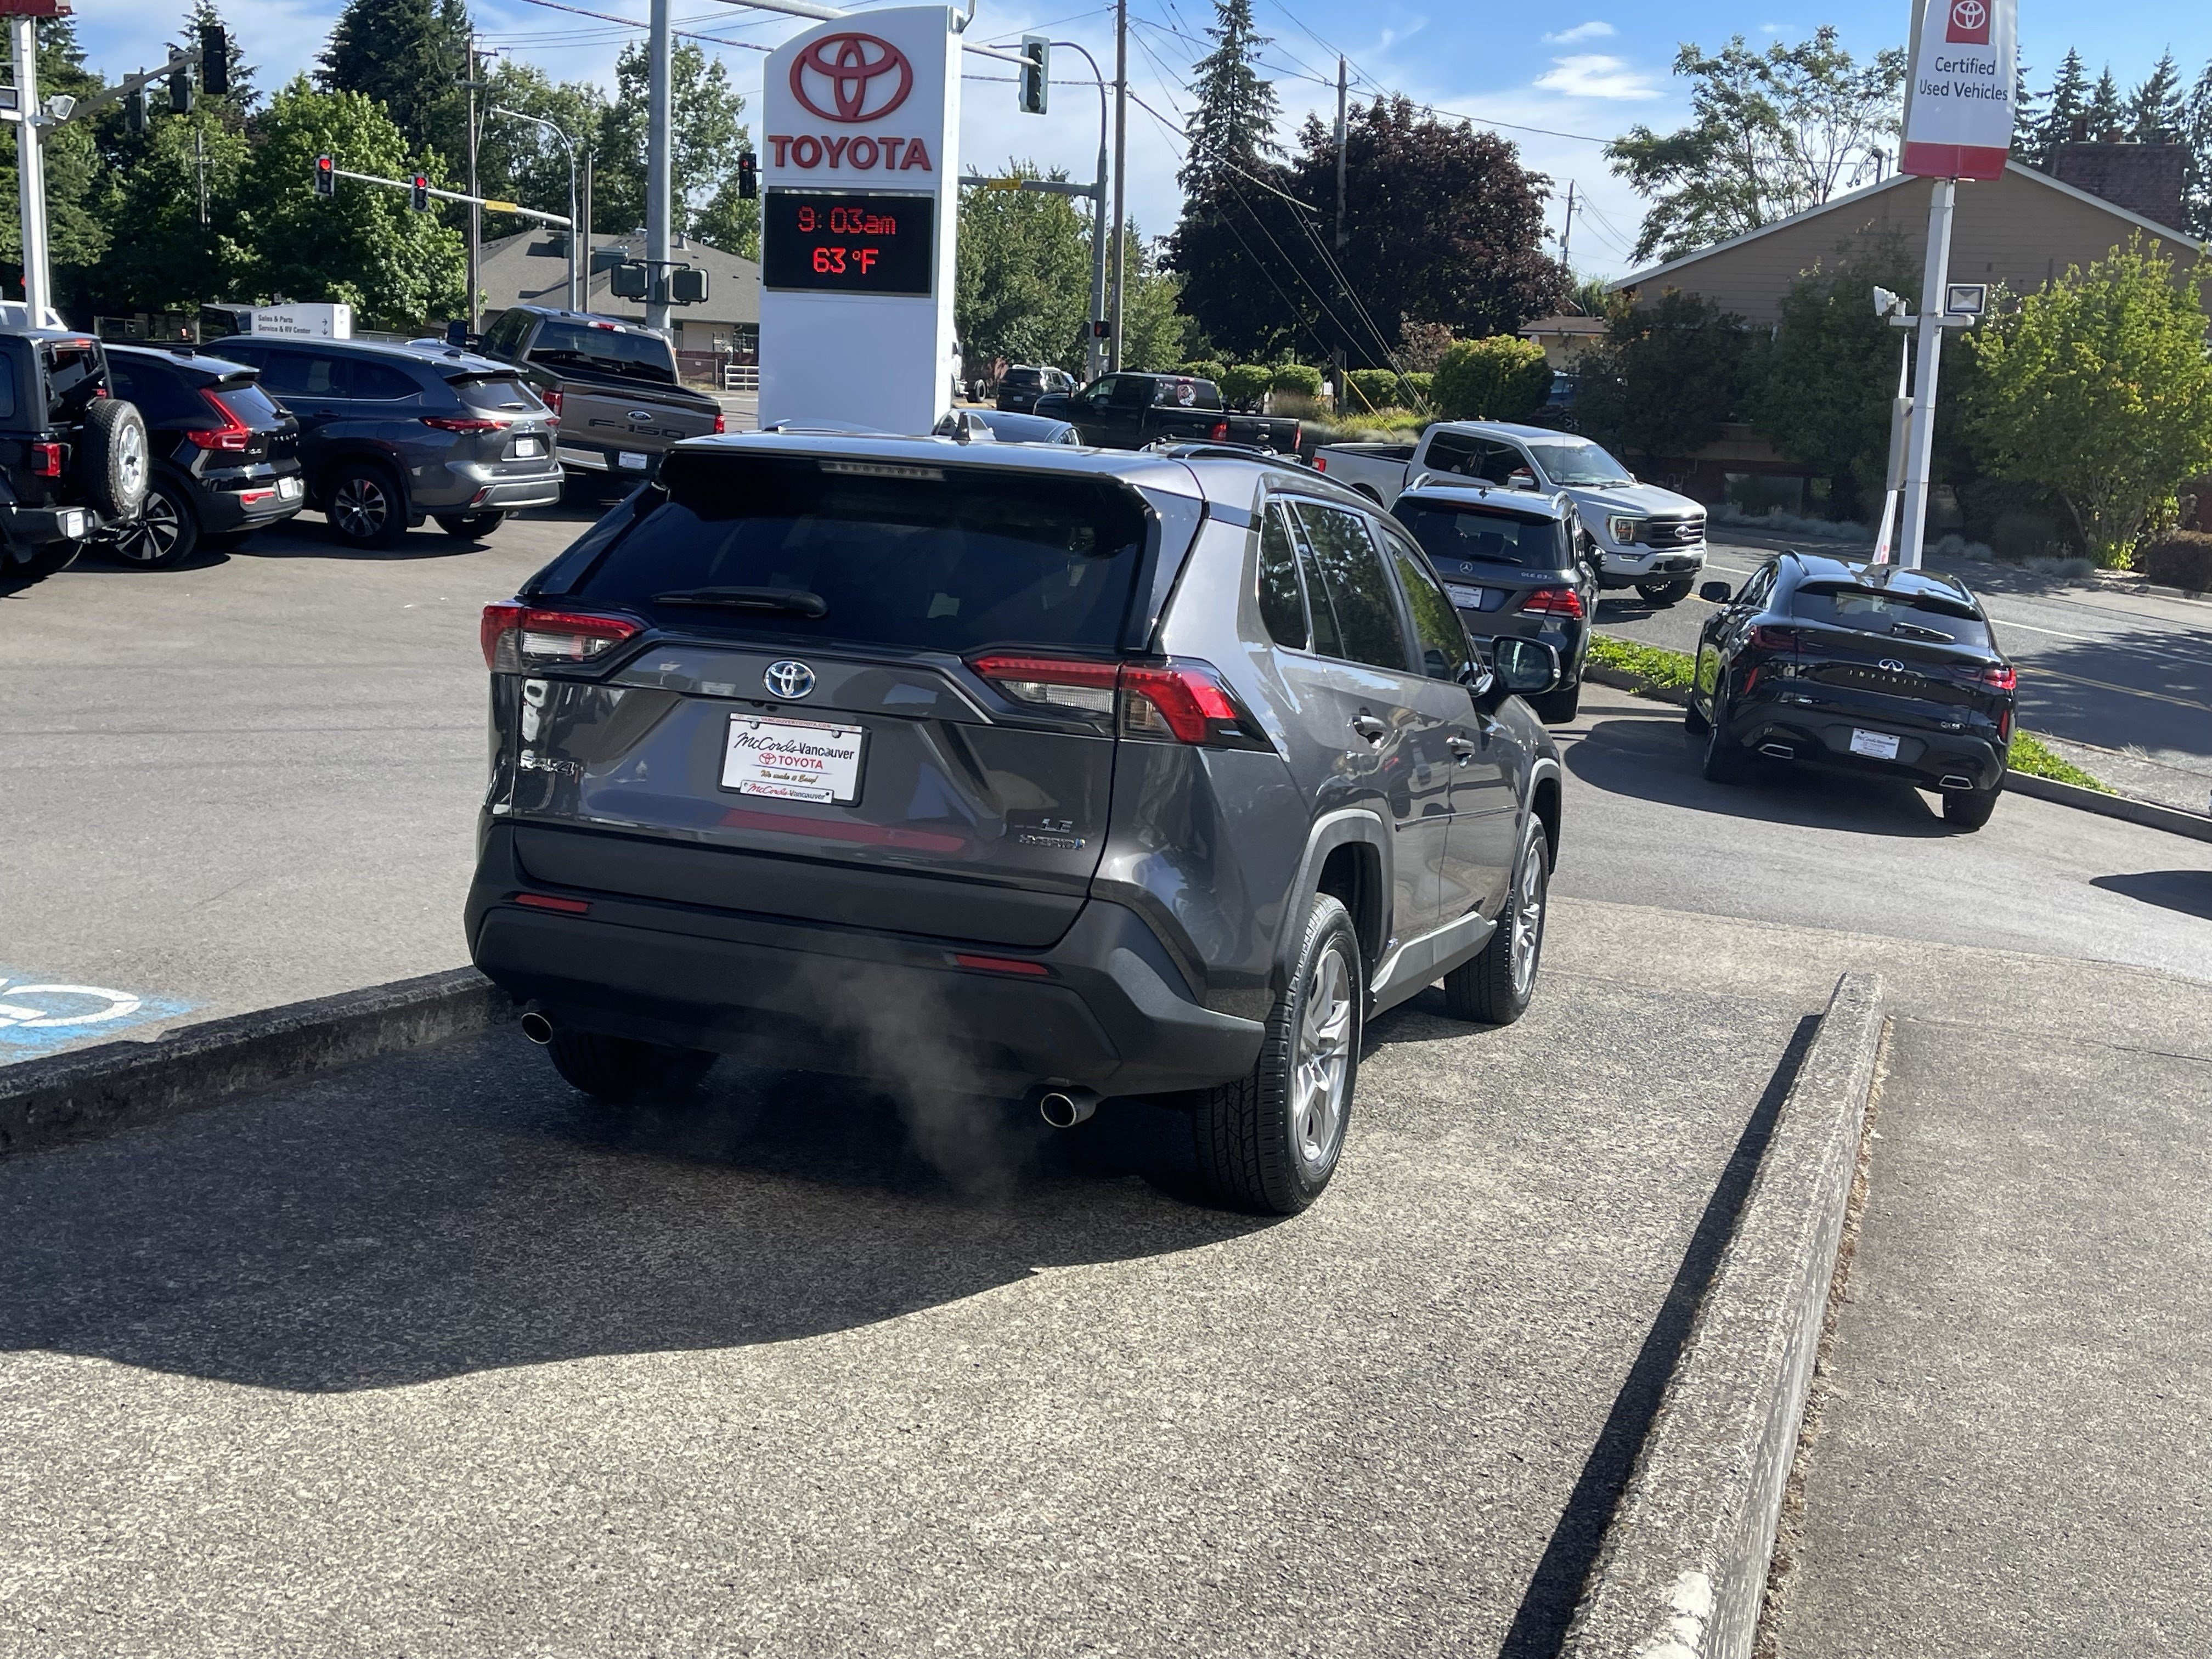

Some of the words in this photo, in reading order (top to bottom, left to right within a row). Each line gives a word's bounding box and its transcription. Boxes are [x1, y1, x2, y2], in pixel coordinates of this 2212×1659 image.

[1935, 57, 1996, 76] Certified
[1920, 79, 1950, 97] Used
[1954, 82, 2008, 101] Vehicles
[768, 135, 933, 171] TOYOTA
[258, 324, 278, 332] Service
[589, 418, 685, 439] F-150
[734, 732, 798, 753] McCords
[799, 742, 855, 760] Vancouver
[778, 755, 823, 770] TOYOTA
[747, 783, 789, 796] McCords
[789, 790, 825, 800] Vancouver
[1042, 818, 1073, 833] LE
